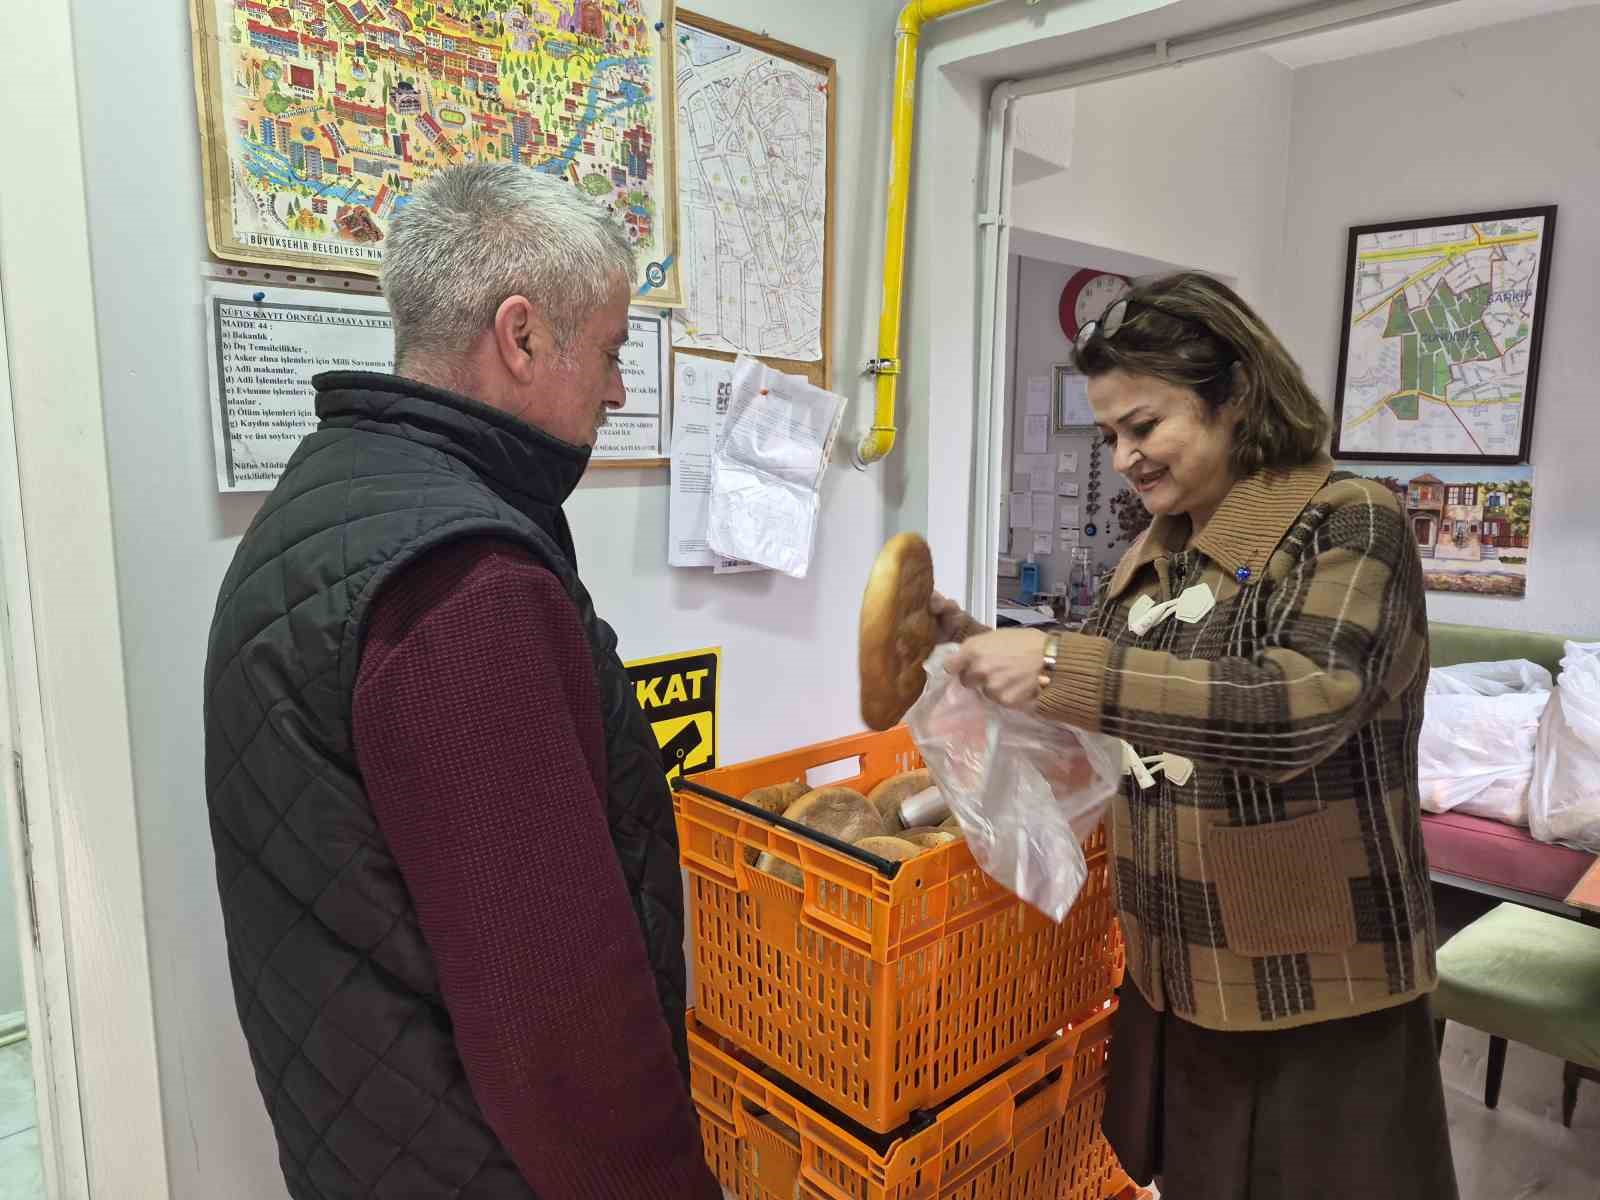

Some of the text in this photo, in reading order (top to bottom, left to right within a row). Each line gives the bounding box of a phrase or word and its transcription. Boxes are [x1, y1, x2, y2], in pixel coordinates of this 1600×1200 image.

[253, 311, 284, 320] KAYIT
[286, 311, 323, 322] ÖRNEĞİ
[222, 319, 255, 329] MADDE
[258, 322, 268, 330] 44
[223, 343, 232, 351] b)
[234, 354, 256, 362] Asker
[280, 356, 314, 365] işlemleri
[316, 357, 330, 366] için
[237, 408, 260, 416] Ölüm
[262, 408, 296, 418] işlemleri
[298, 409, 312, 418] için
[272, 420, 306, 429] sahipleri
[630, 668, 709, 709] KAT
